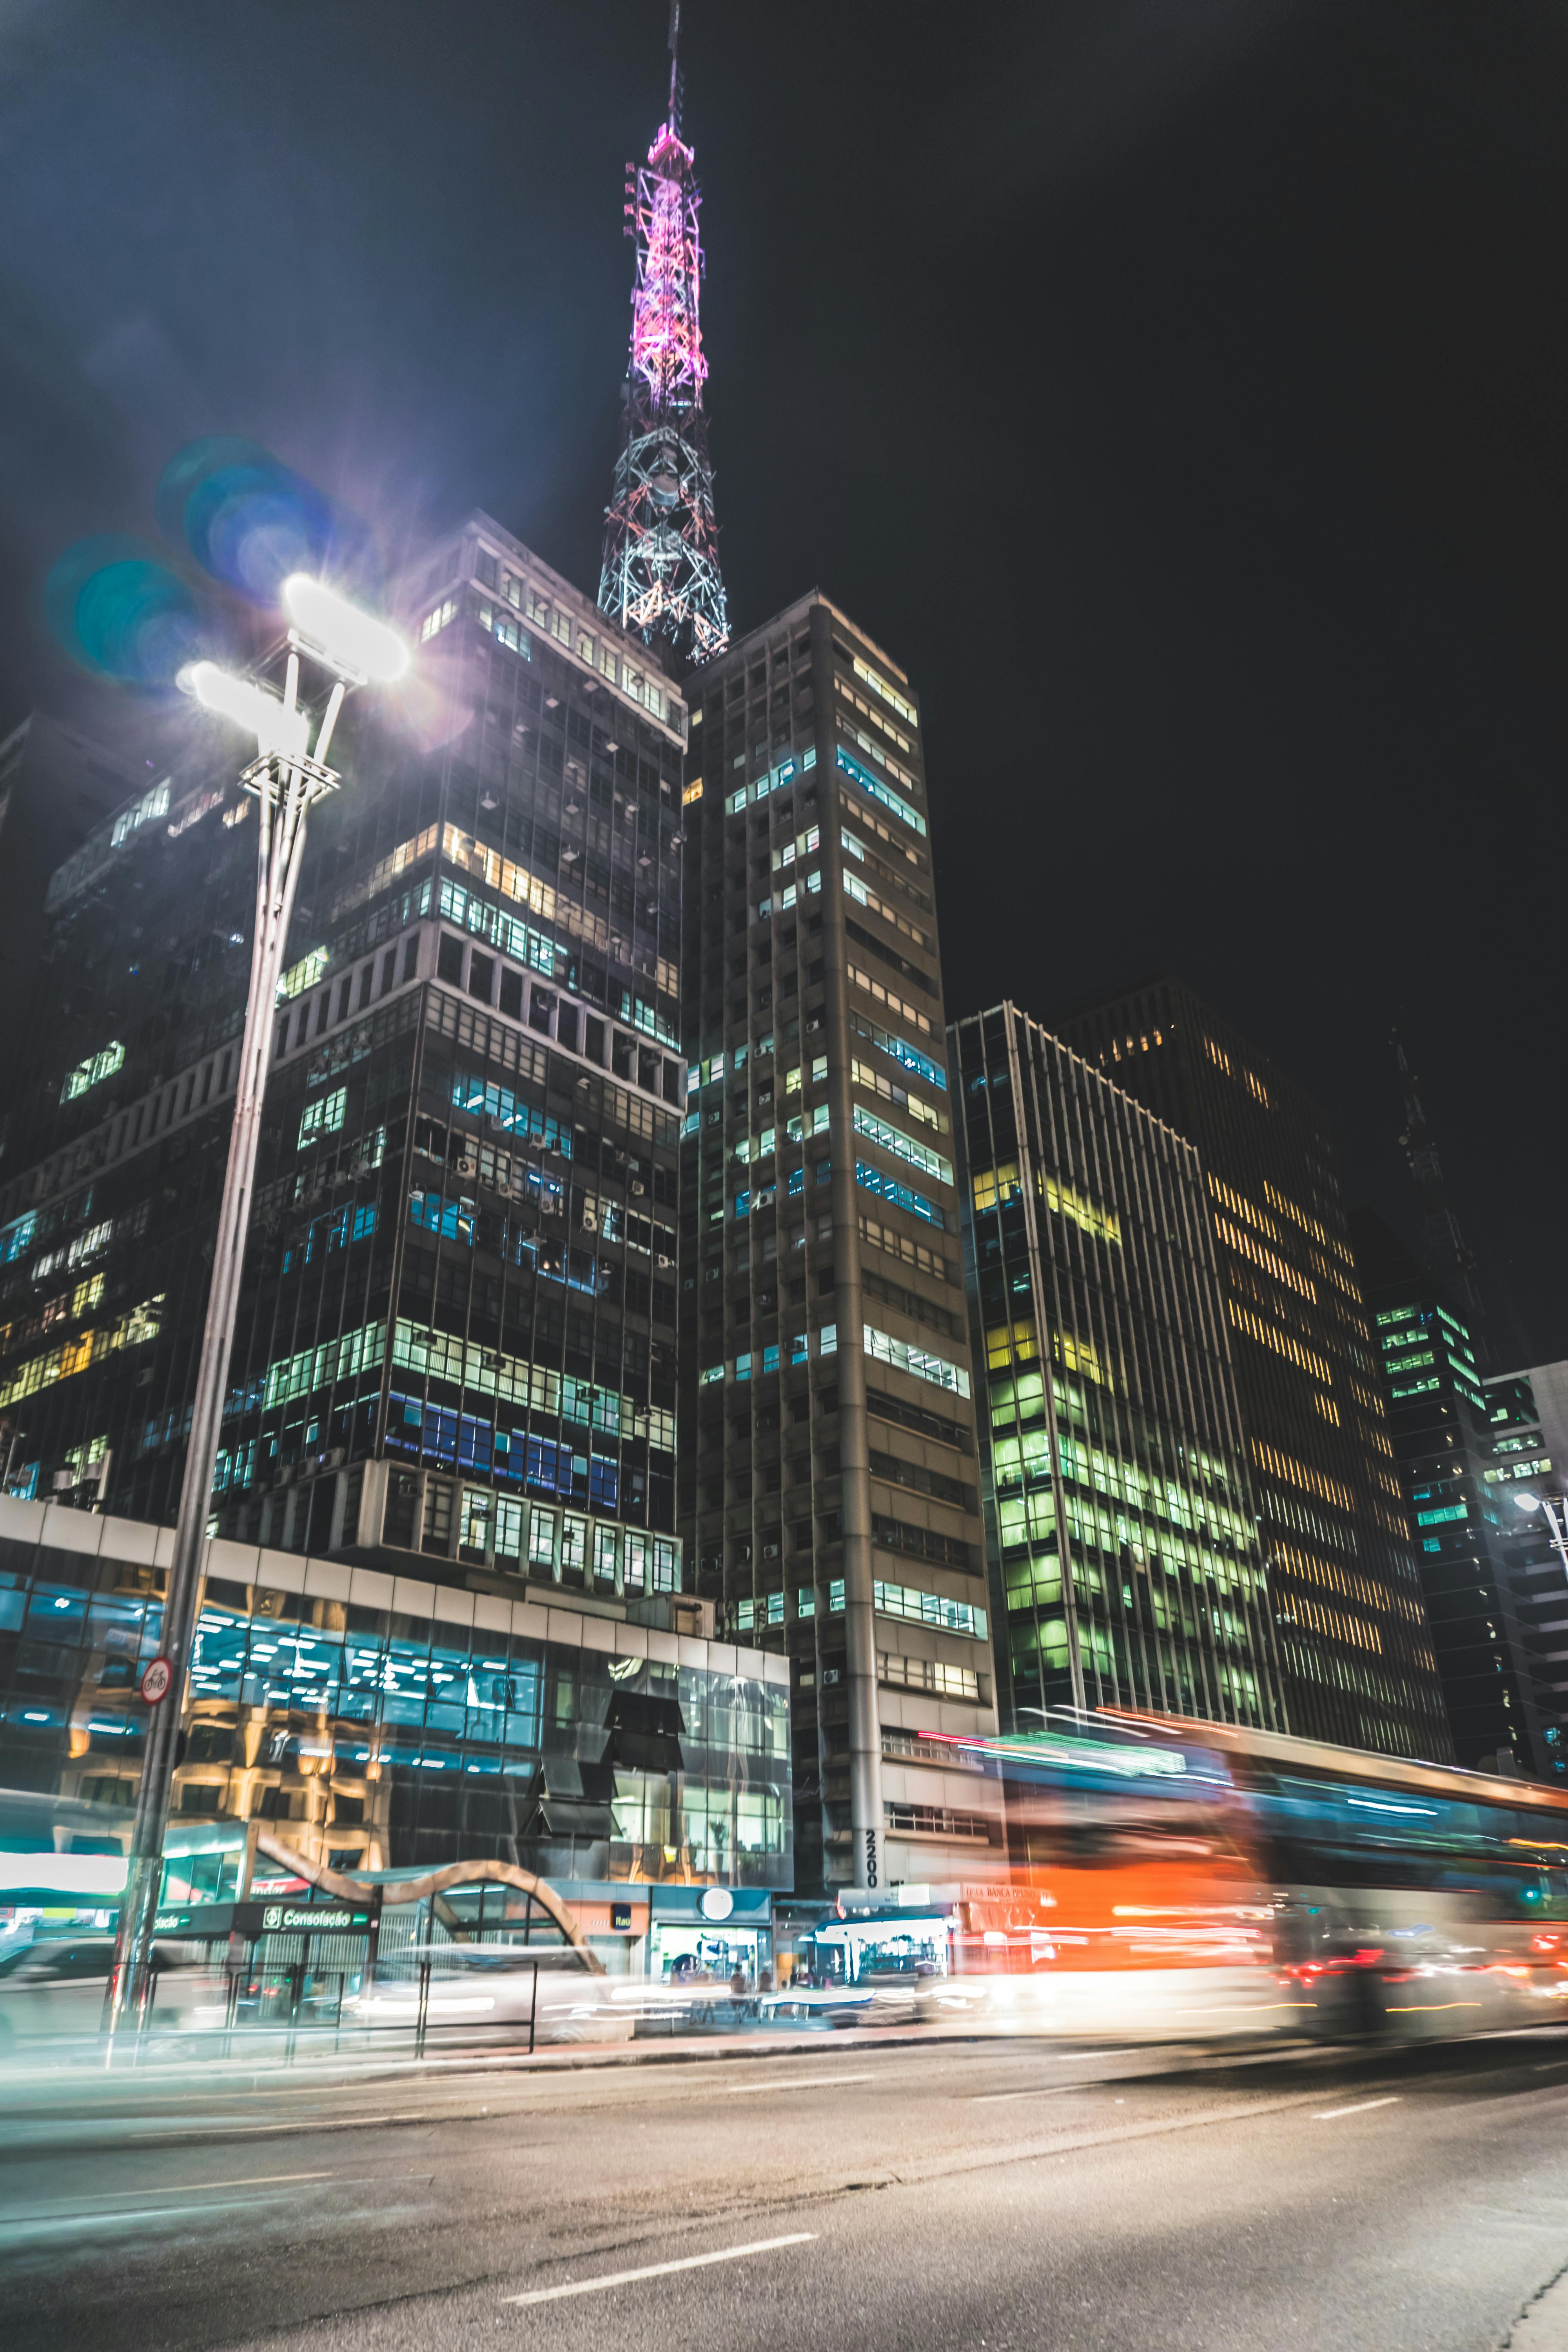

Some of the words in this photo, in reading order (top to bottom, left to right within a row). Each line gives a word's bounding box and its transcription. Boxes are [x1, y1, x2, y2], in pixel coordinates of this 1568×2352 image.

[866, 1829, 877, 1888] 2200
[250, 1882, 287, 1895] ander
[987, 1887, 1010, 1898] BANCA
[1013, 1888, 1035, 1900] BRUNO
[154, 1913, 180, 1930] olação
[283, 1908, 351, 1928] Consolação
[615, 1916, 631, 1926] Itaú
